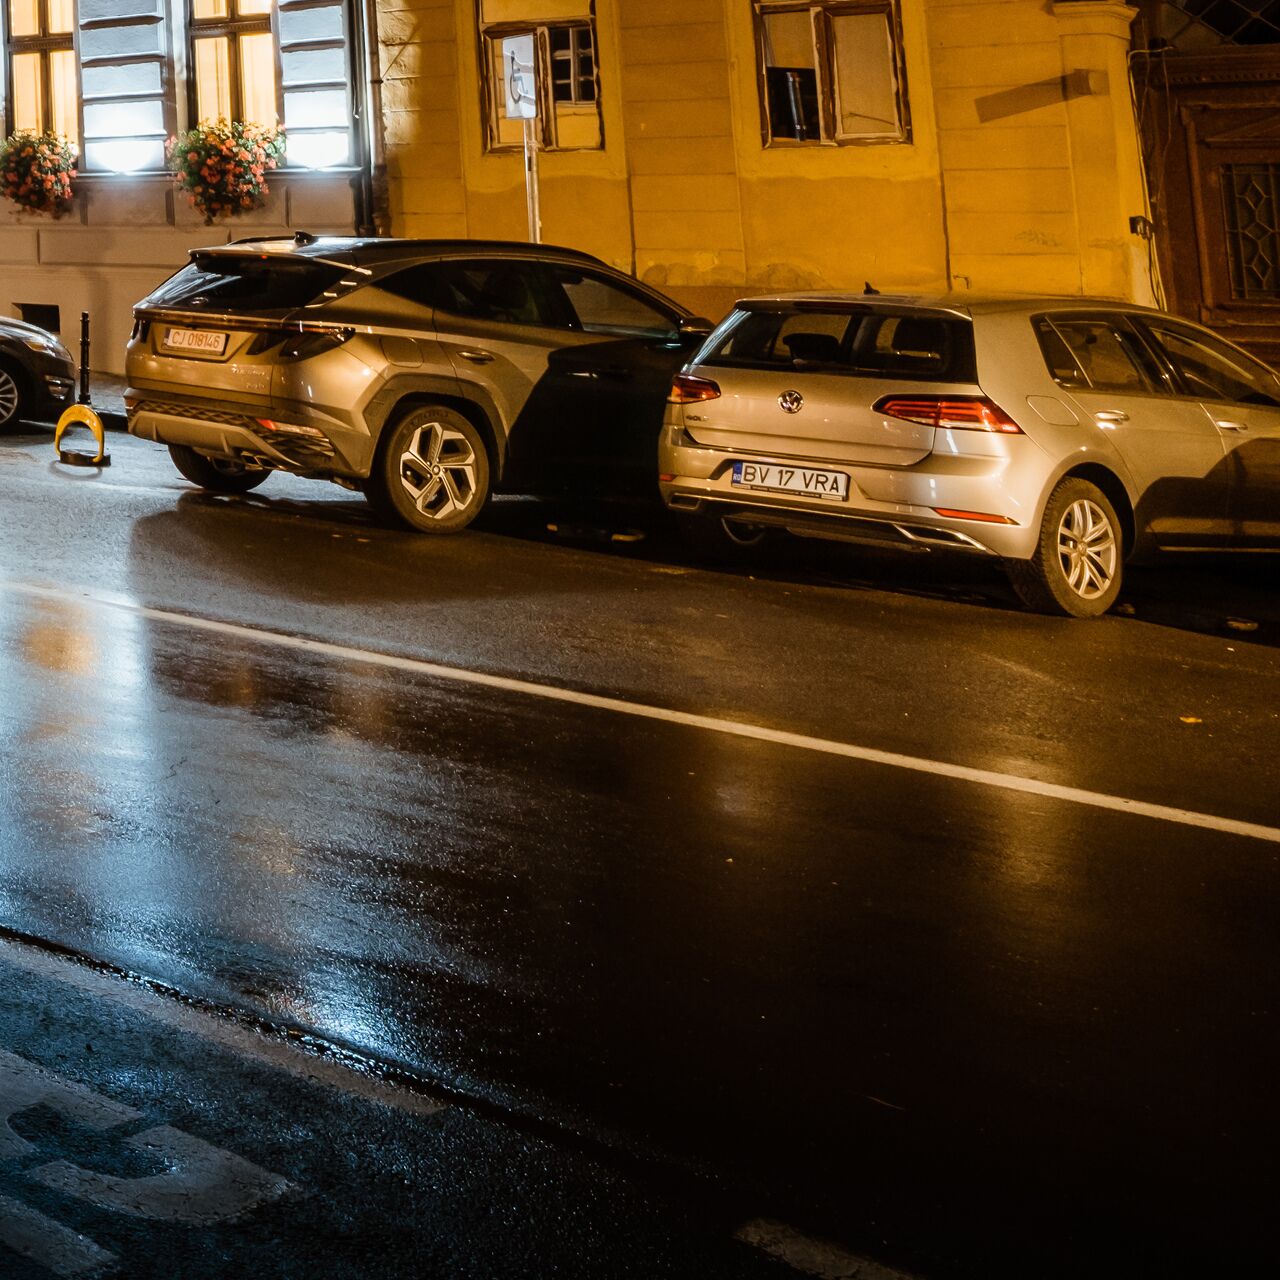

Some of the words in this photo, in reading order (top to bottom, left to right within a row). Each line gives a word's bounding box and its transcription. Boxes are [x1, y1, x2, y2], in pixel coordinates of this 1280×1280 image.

[172, 331, 186, 346] CJ
[187, 333, 221, 349] 018146
[743, 464, 770, 484] BV
[777, 469, 795, 487] 17
[802, 471, 840, 493] VRA
